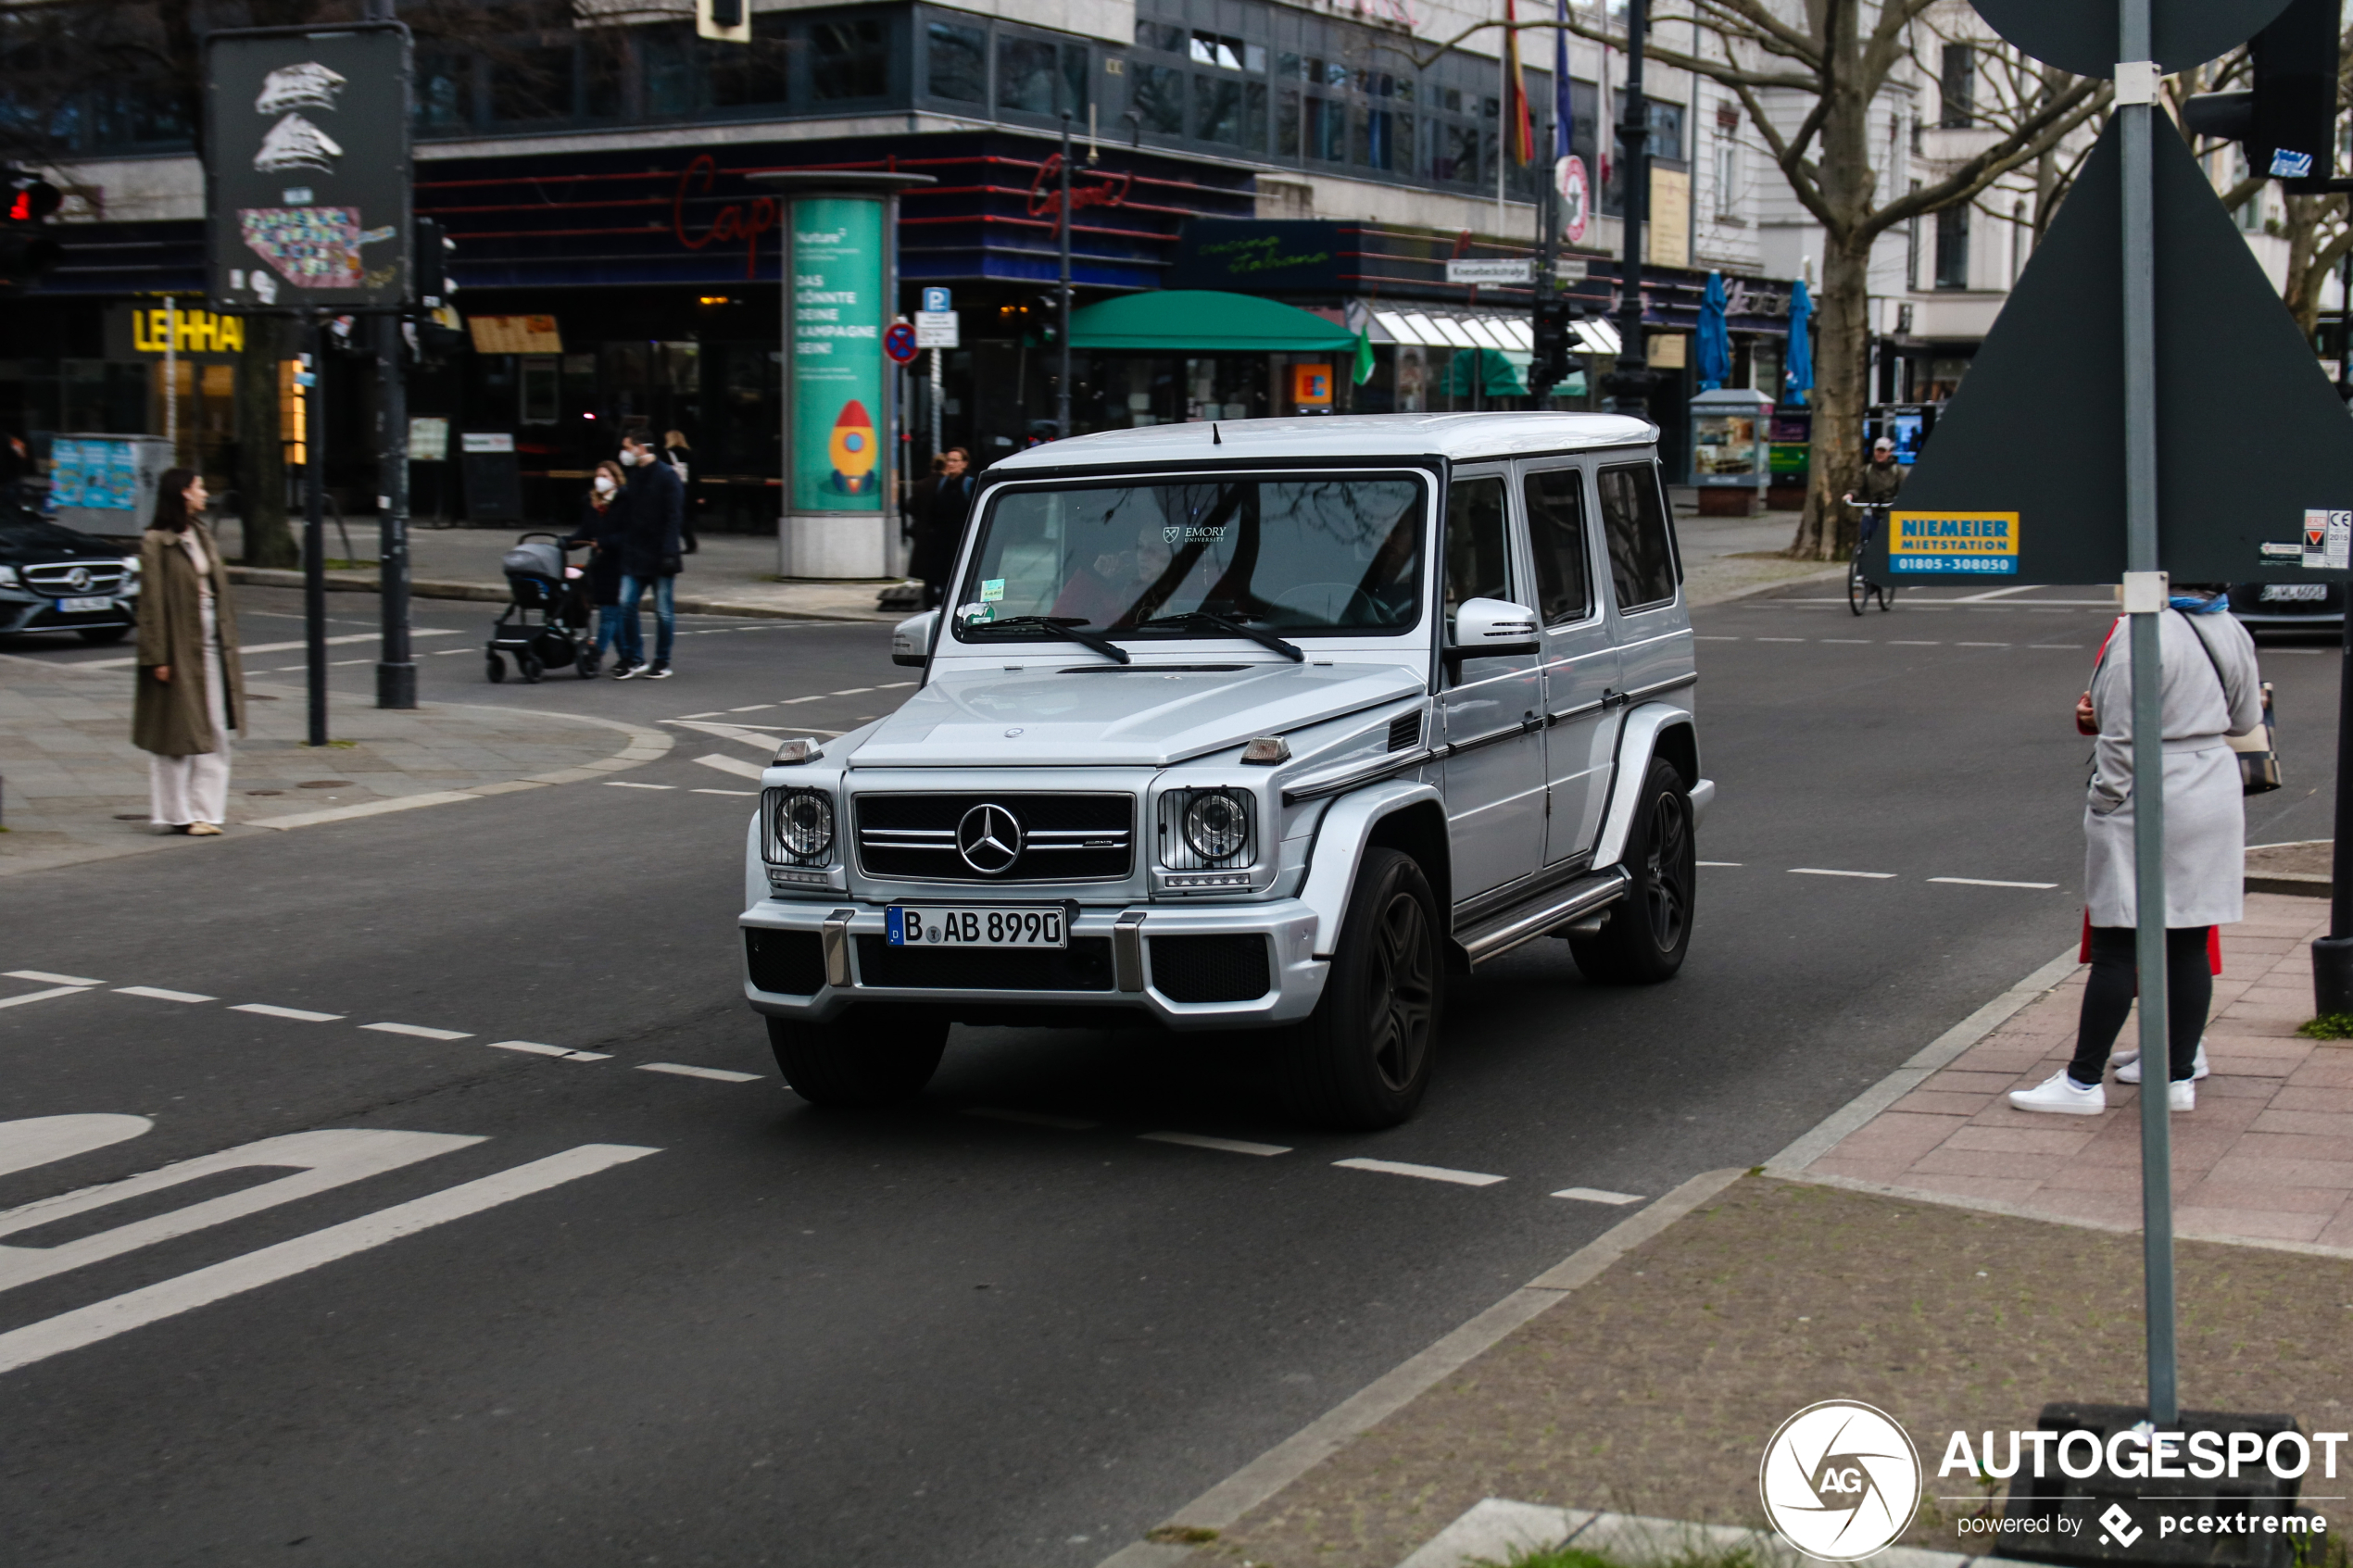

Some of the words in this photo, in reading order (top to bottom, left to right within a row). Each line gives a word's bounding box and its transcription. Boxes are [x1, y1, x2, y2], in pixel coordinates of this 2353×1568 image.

[674, 154, 784, 280] Cap
[797, 289, 856, 304] KÖNNTE
[797, 308, 838, 320] DEINE
[797, 325, 877, 338] KAMPAGNE
[1185, 526, 1227, 537] EMORY
[1901, 520, 2009, 537] NIEMEIER
[2329, 533, 2348, 542] 2015
[1901, 540, 2008, 550] MIETSTATION
[904, 911, 924, 941] B
[943, 912, 980, 942] AB
[987, 911, 1061, 943] 8990
[892, 930, 899, 939] D
